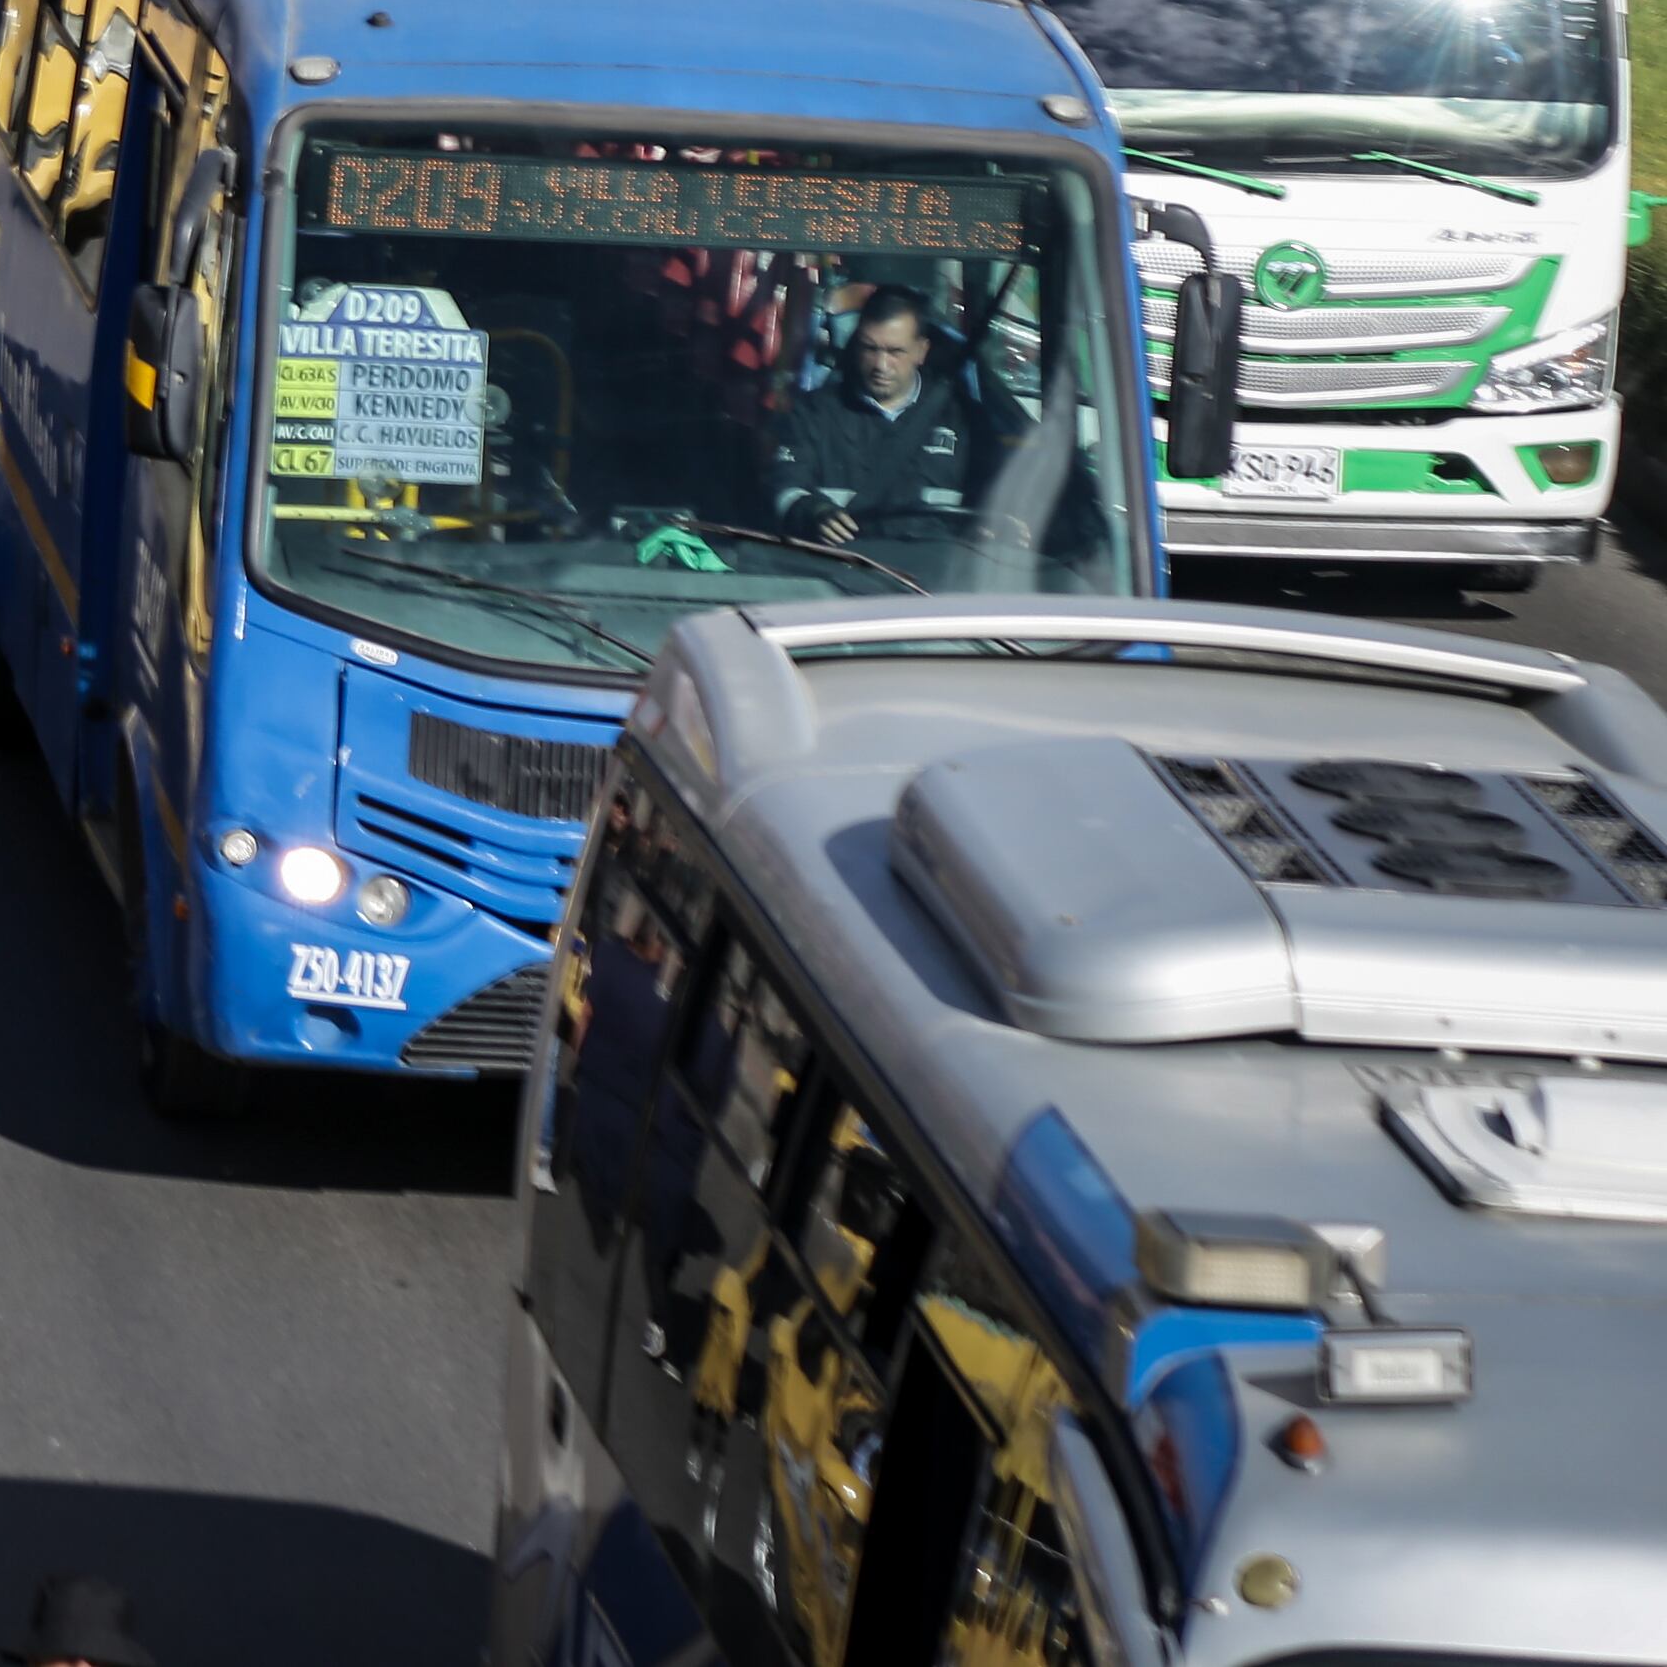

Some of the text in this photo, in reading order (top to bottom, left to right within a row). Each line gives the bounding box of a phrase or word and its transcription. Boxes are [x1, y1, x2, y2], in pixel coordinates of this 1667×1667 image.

[328, 155, 501, 231] D209
[343, 290, 421, 324] D209
[280, 324, 484, 364] VILLA TERESITA
[352, 363, 471, 392] PERDOMO
[355, 394, 465, 422] KENNEDY
[381, 427, 479, 449] HAYUELOS
[275, 449, 333, 474] CL 67
[288, 942, 410, 1000] Z50-4137
